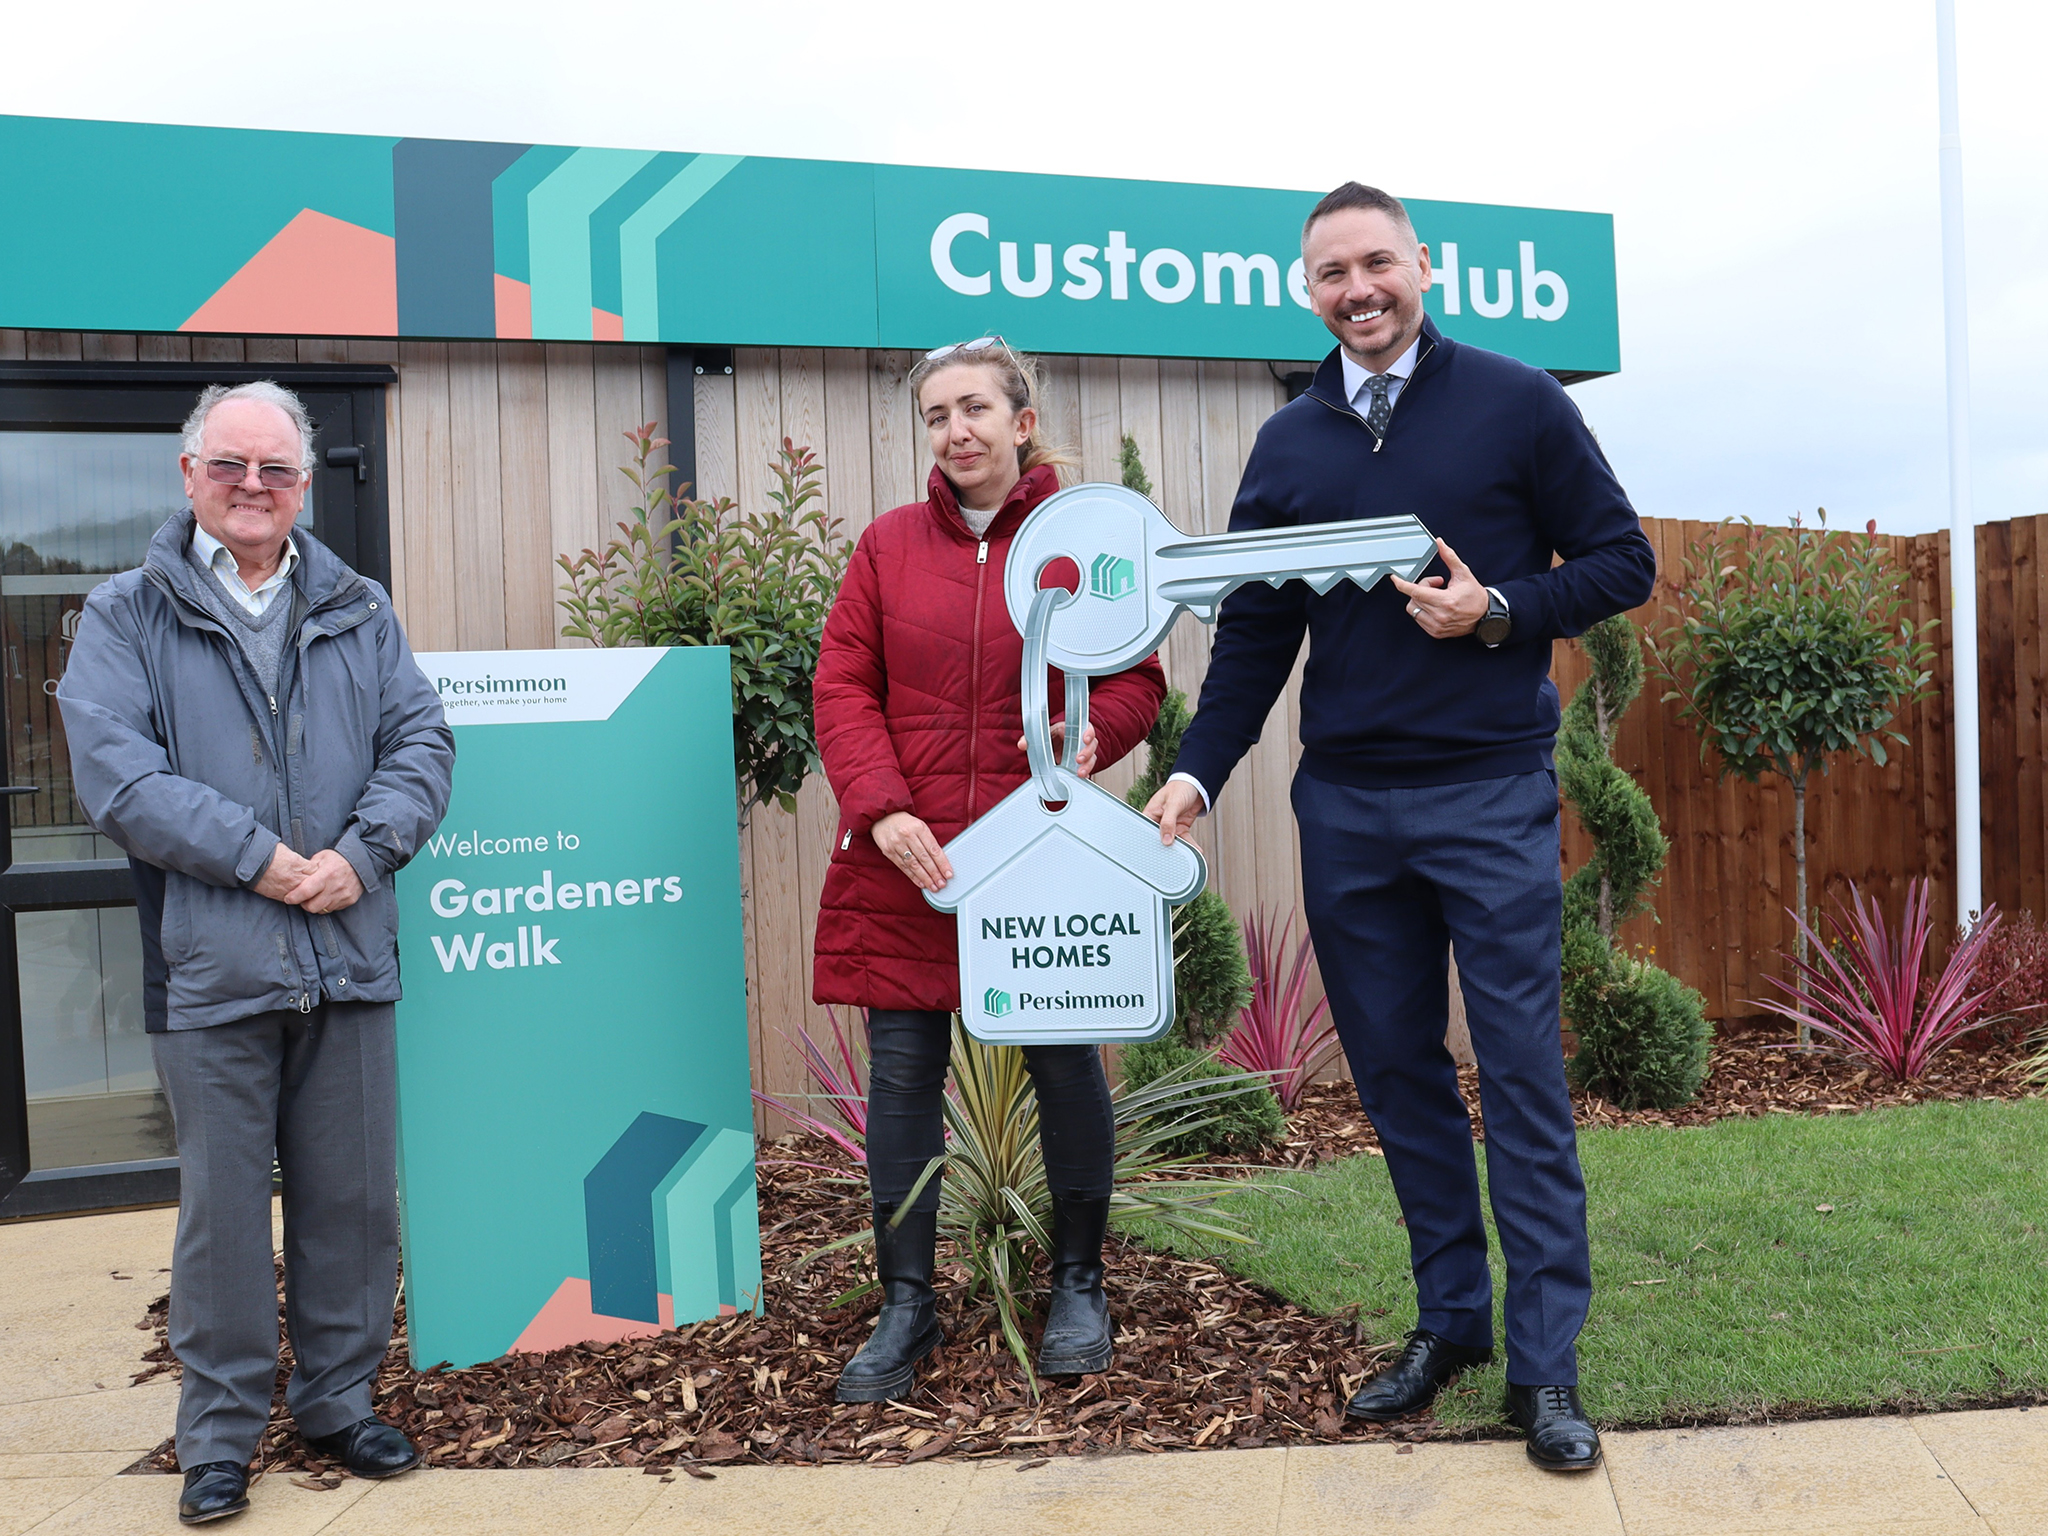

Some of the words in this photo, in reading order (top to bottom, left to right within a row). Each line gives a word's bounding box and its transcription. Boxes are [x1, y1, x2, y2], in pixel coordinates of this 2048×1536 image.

[1431, 240, 1569, 322] Hub
[437, 674, 566, 695] Persimmon
[441, 698, 481, 710] ogether,
[497, 696, 520, 705] make
[522, 697, 541, 707] your
[544, 695, 568, 704] home
[428, 829, 548, 858] Welcome
[556, 830, 580, 851] to
[430, 869, 683, 919] Gardeners
[981, 915, 1046, 940] NEW
[1054, 912, 1141, 938] LOCAL
[430, 924, 562, 973] Walk
[1012, 944, 1112, 969] HOMES
[1019, 989, 1144, 1011] Persimmon
